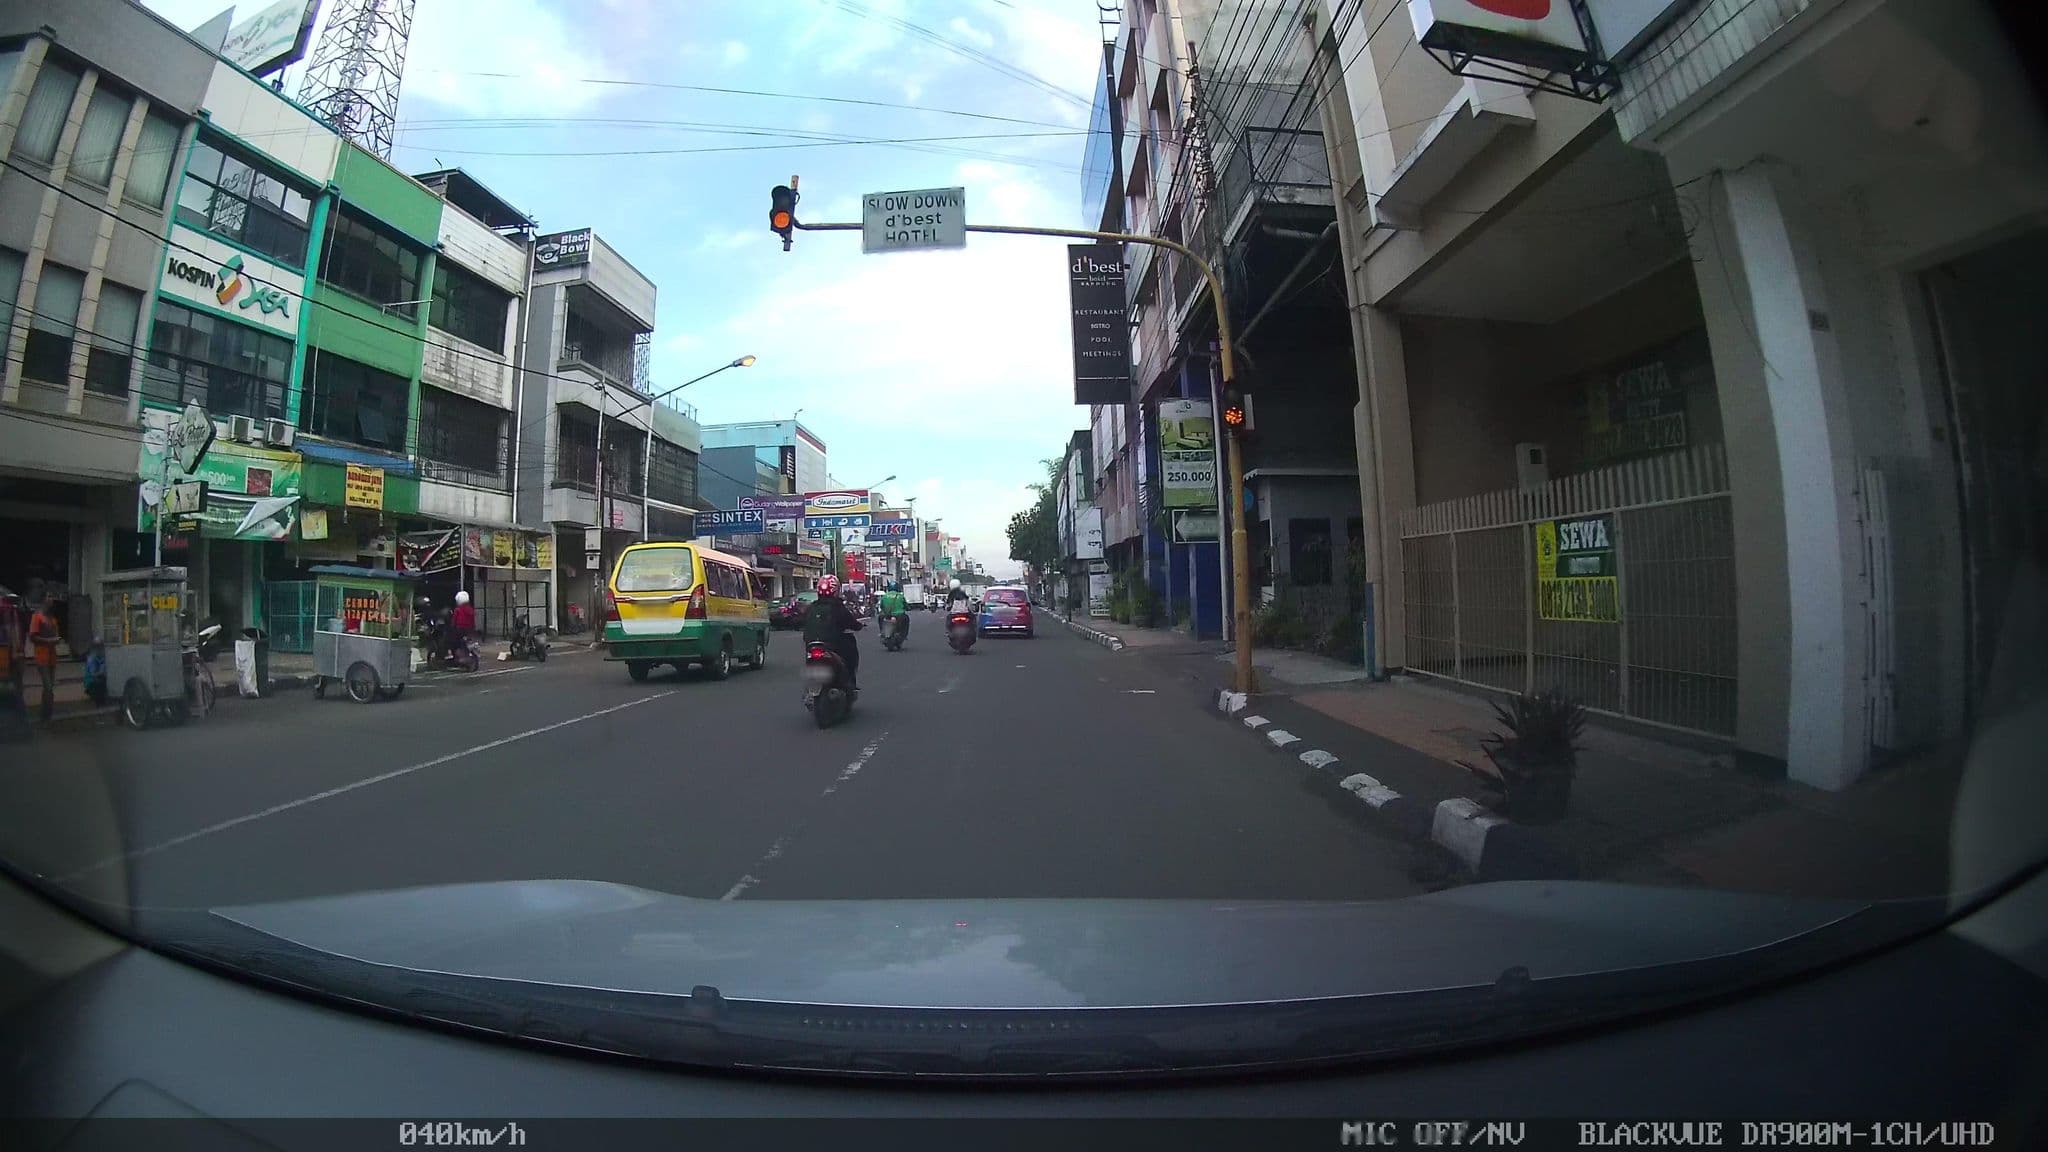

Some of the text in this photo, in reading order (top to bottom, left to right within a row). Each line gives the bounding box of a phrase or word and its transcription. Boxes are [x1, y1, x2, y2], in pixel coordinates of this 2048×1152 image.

[915, 194, 959, 209] DOWN
[885, 212, 942, 227] d'best
[560, 231, 591, 245] Black
[560, 241, 589, 255] Bowl
[1072, 255, 1123, 273] d'best
[167, 258, 216, 289] KOSPIN
[1167, 471, 1212, 482] 250.000
[712, 510, 762, 523] SINTEX
[870, 523, 908, 536] TIKI
[1560, 520, 1609, 550] SEWA
